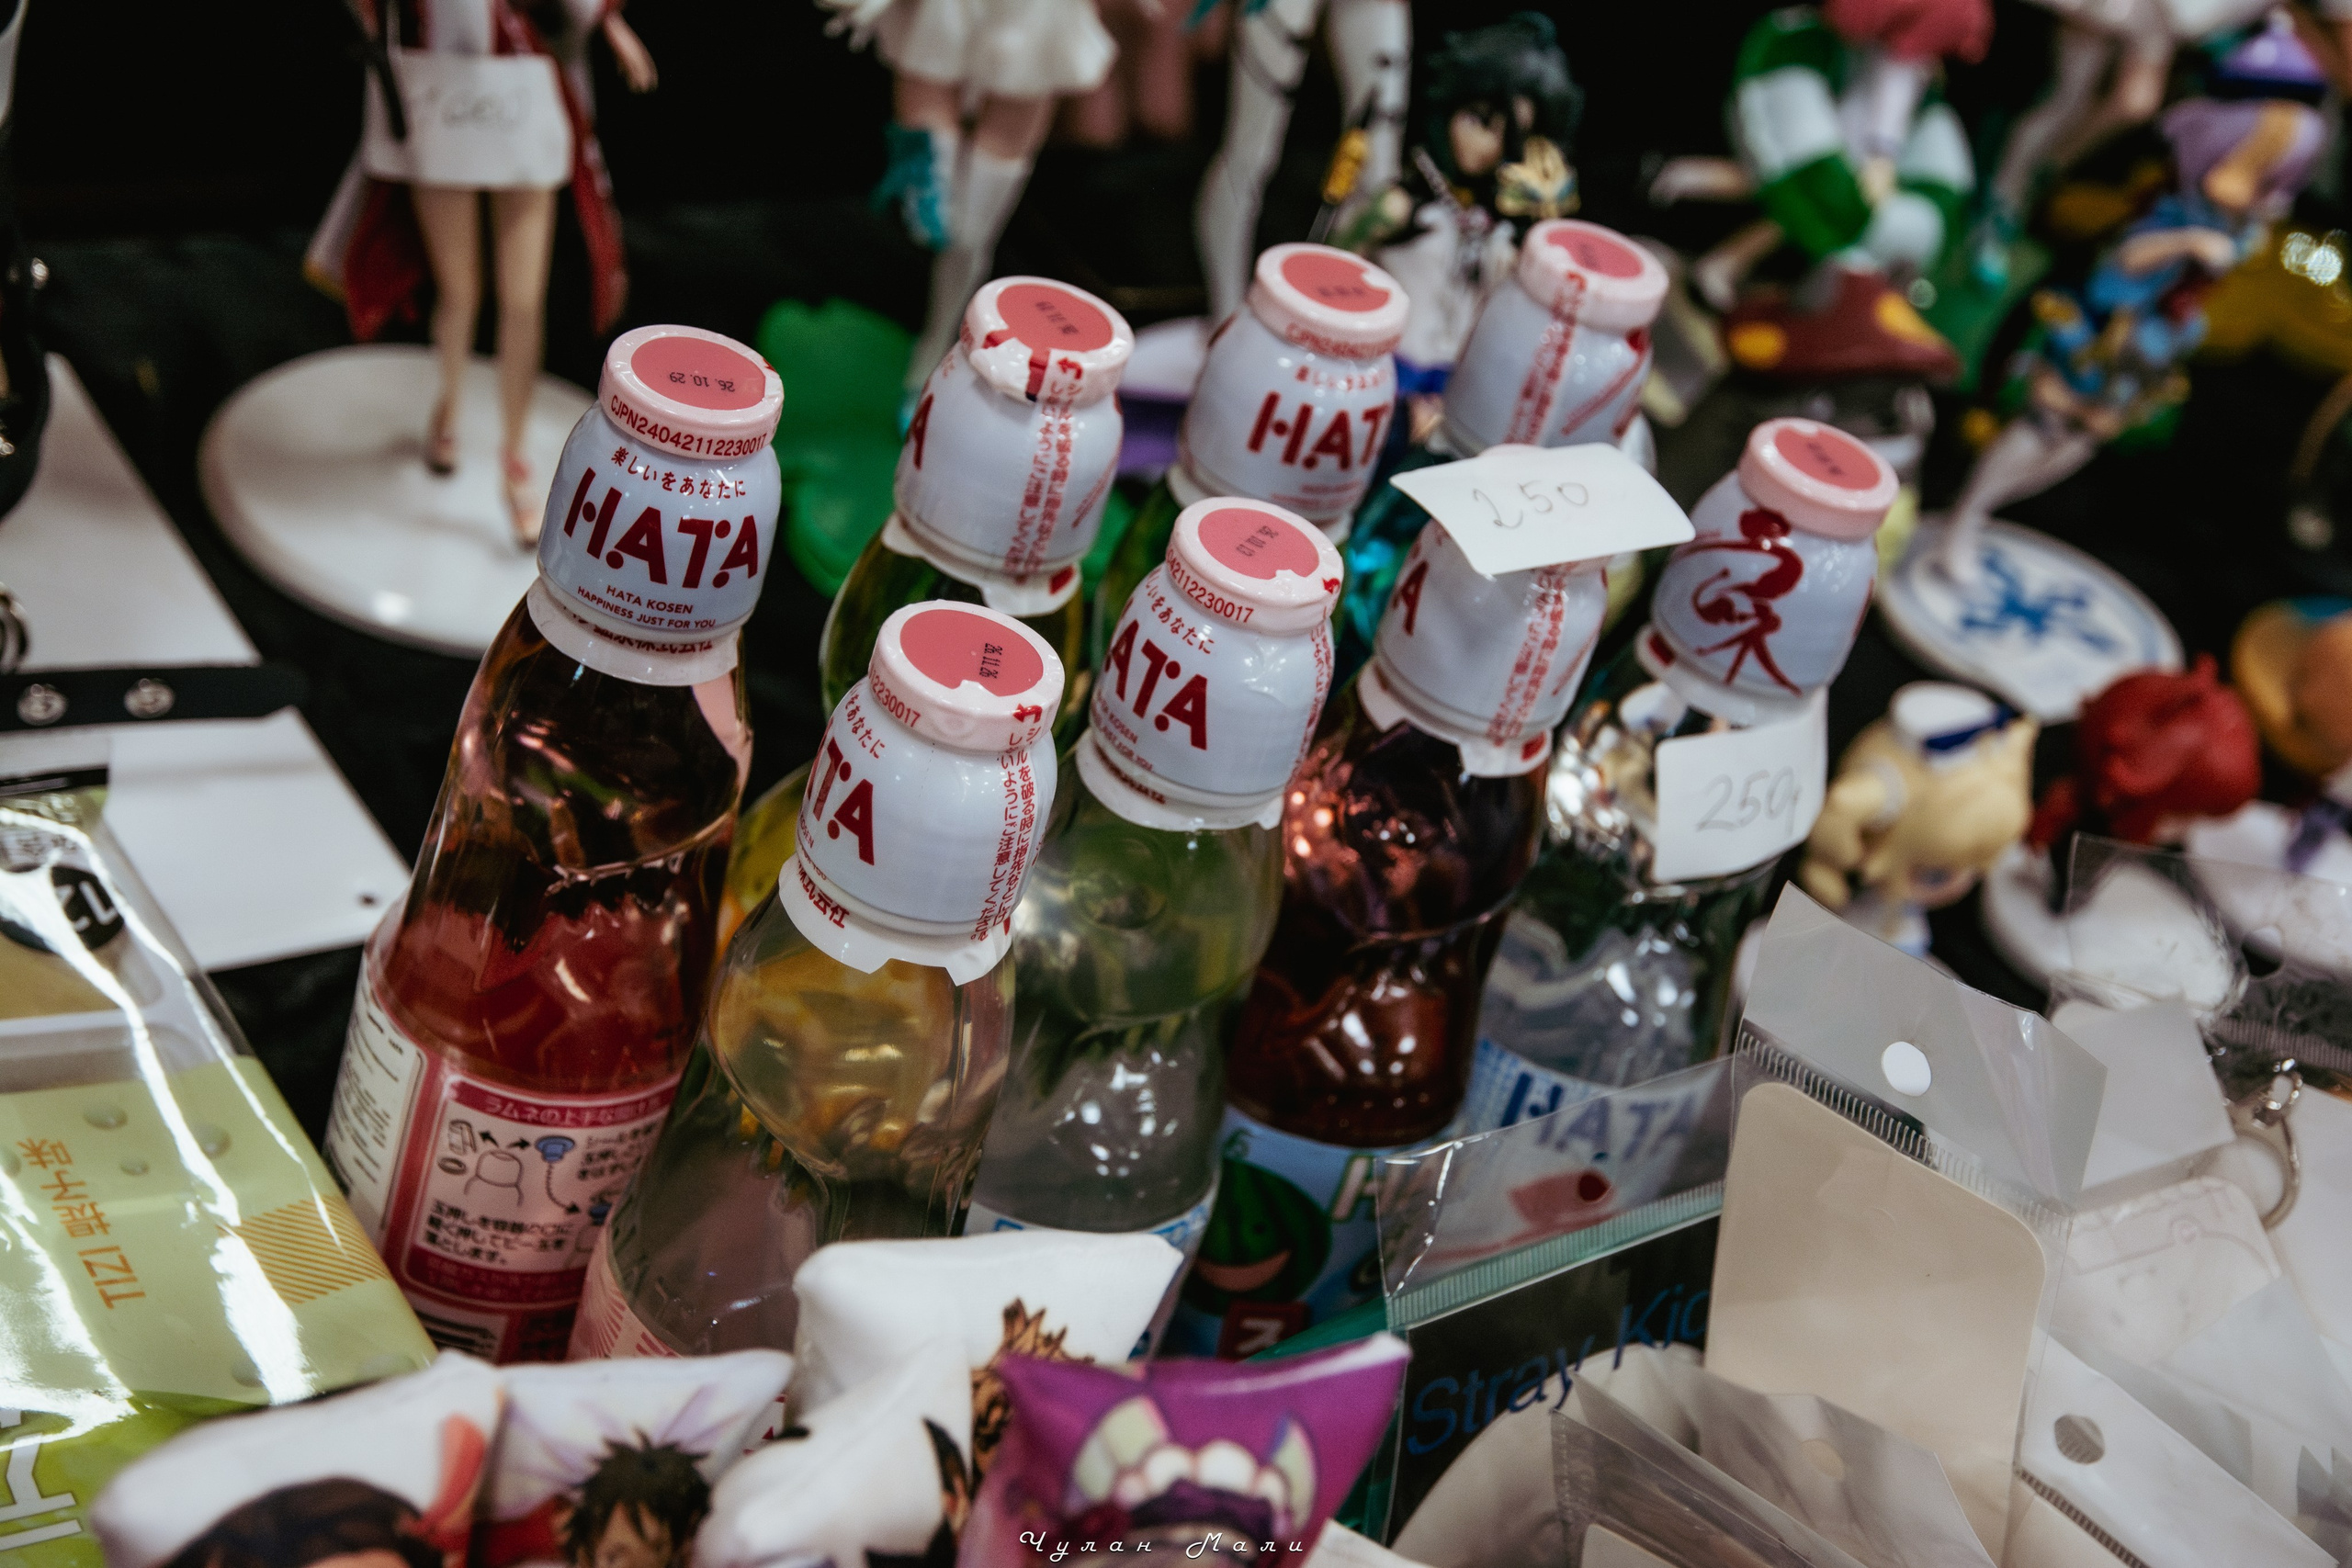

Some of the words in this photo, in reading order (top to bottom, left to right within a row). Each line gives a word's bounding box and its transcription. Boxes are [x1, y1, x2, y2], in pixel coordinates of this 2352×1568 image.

[610, 393, 768, 458] CJPN24042112230017
[610, 445, 747, 500] 楽しいをあなたに
[1471, 479, 1589, 530] 250
[563, 466, 759, 590] HATA
[577, 585, 634, 620] HAPPINESS
[637, 612, 664, 628] JUST
[667, 617, 692, 629] FOR
[694, 617, 717, 629] YOU
[606, 584, 642, 606] HATA
[647, 596, 694, 615] KOSEN
[16, 1137, 113, 1239] 提子味
[77, 1244, 147, 1311] TIZI
[1406, 1334, 1596, 1456] Stray
